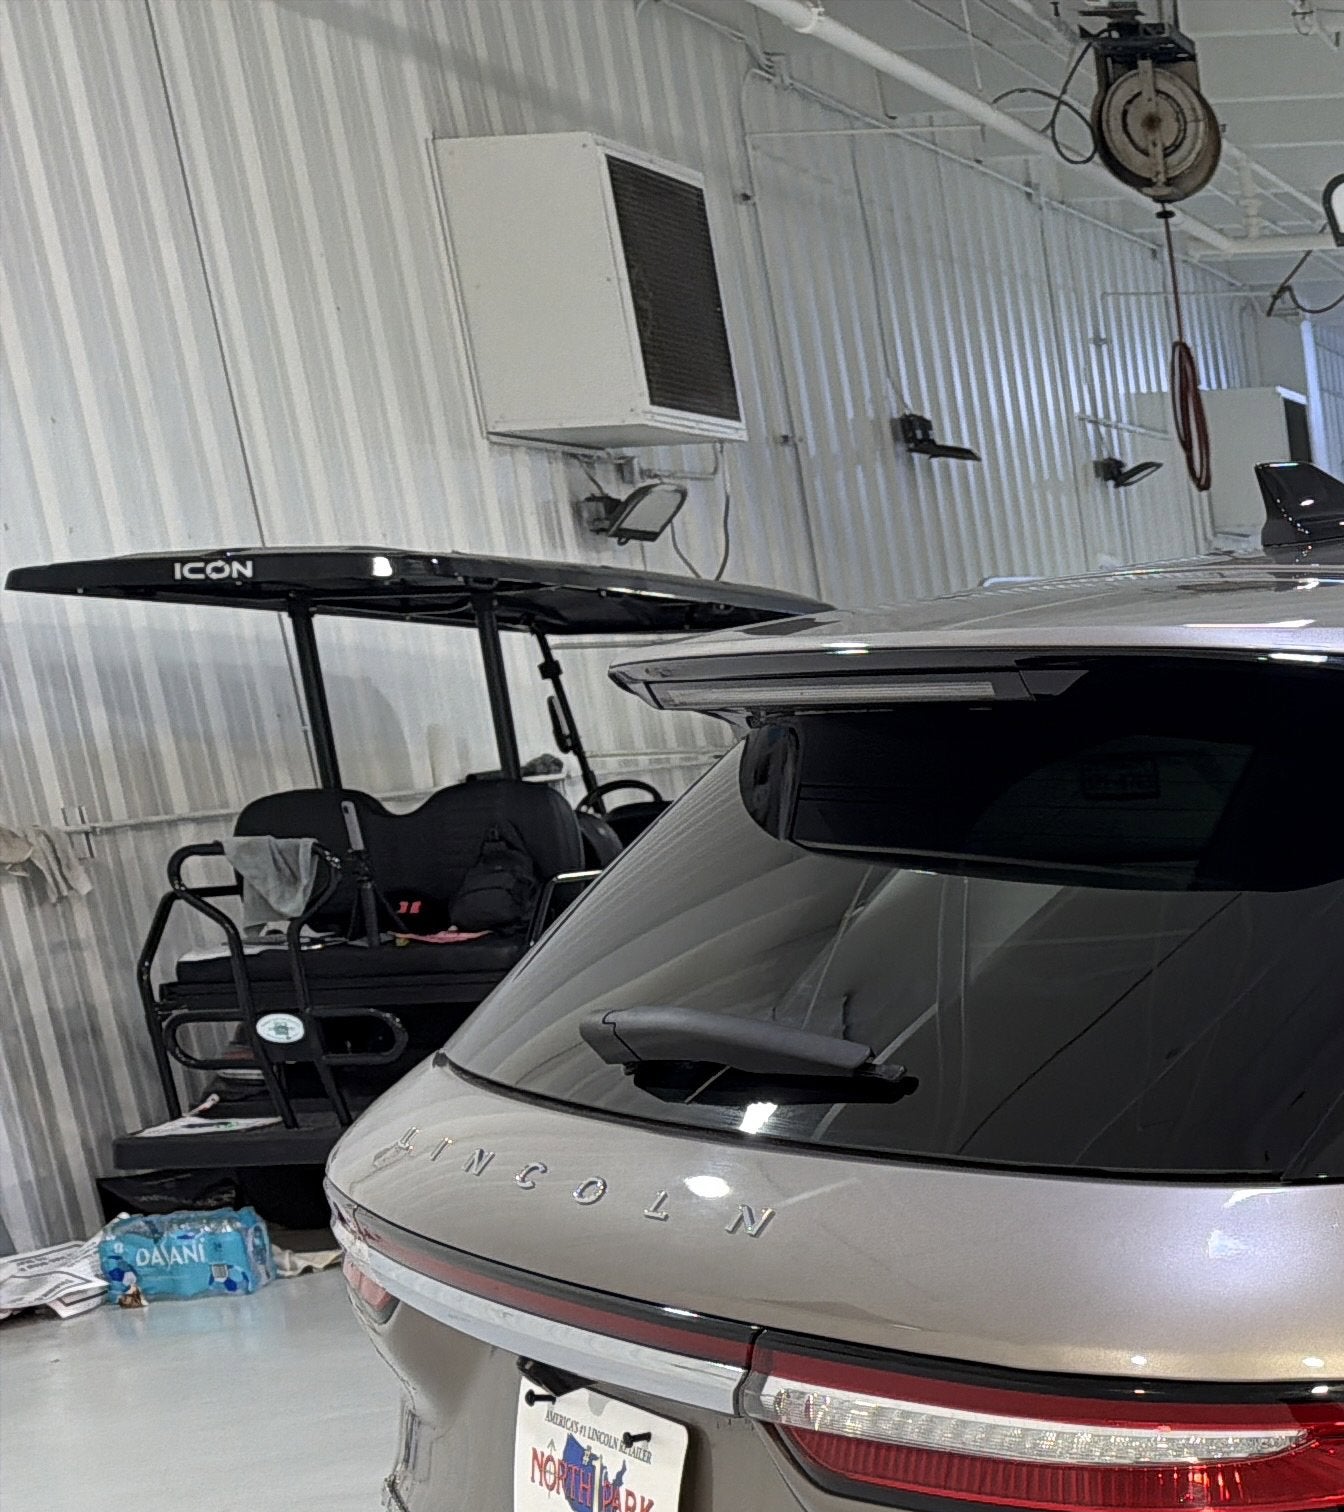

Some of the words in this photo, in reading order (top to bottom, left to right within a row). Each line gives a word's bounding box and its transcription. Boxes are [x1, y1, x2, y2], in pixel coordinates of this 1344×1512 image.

[174, 560, 253, 580] ICON
[399, 1126, 776, 1238] LINCOLN
[135, 1238, 206, 1271] DASANI
[544, 1409, 580, 1434] AMERICA'S
[587, 1426, 619, 1451] LINCOLN
[531, 1447, 592, 1508] NORTH
